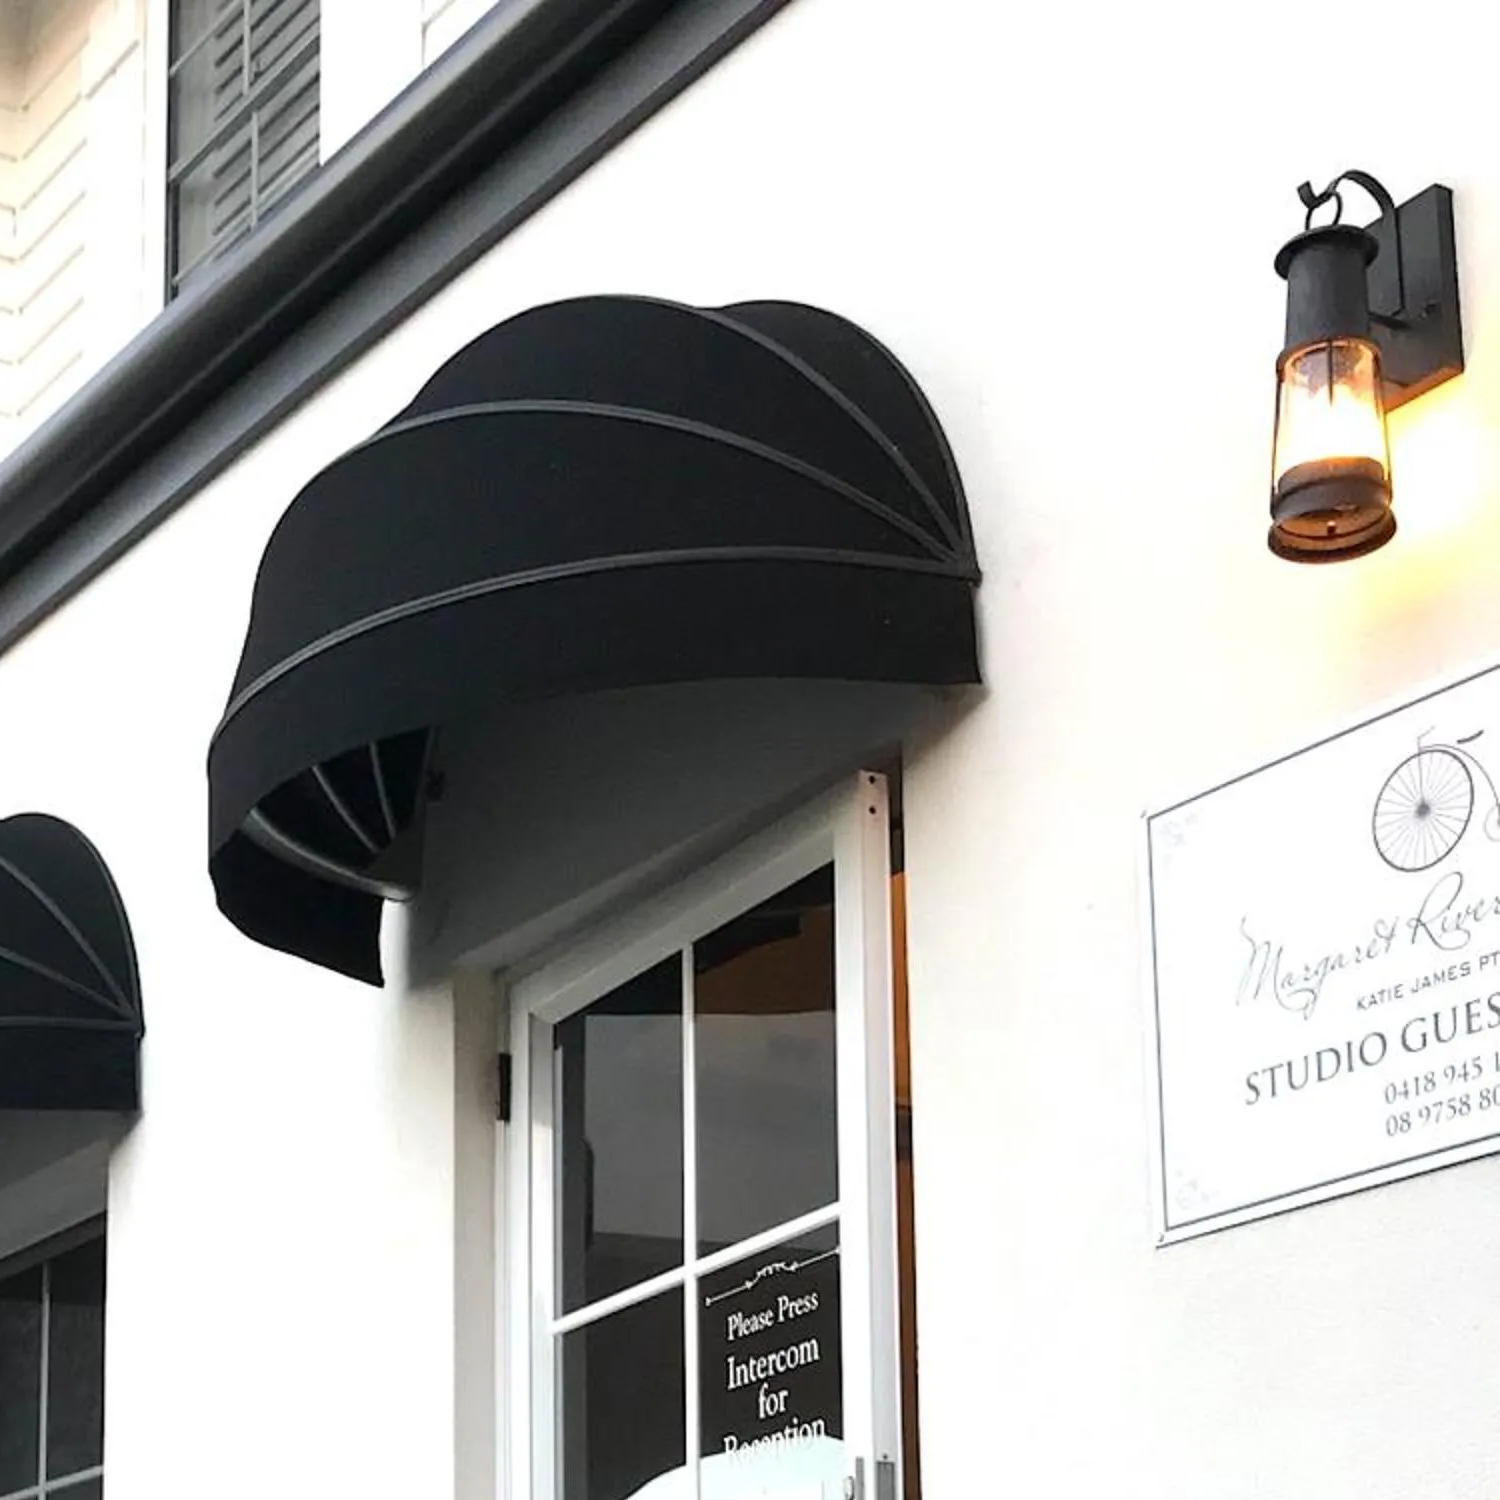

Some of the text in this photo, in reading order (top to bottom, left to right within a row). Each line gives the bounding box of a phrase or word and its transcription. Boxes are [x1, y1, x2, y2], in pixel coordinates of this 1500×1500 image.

[1236, 912, 1399, 1020] Margaret
[1357, 983, 1404, 1010] KATIE
[1411, 961, 1472, 994] JAMES
[1245, 991, 1500, 1106] STUDIO GUES
[1384, 1071, 1437, 1105] 0418
[1443, 1055, 1484, 1084] 945
[1385, 1110, 1412, 1138] 08
[1418, 1092, 1472, 1127] 9758
[727, 1291, 819, 1342] Please Press
[727, 1337, 820, 1390] Intercom
[758, 1382, 789, 1418] for
